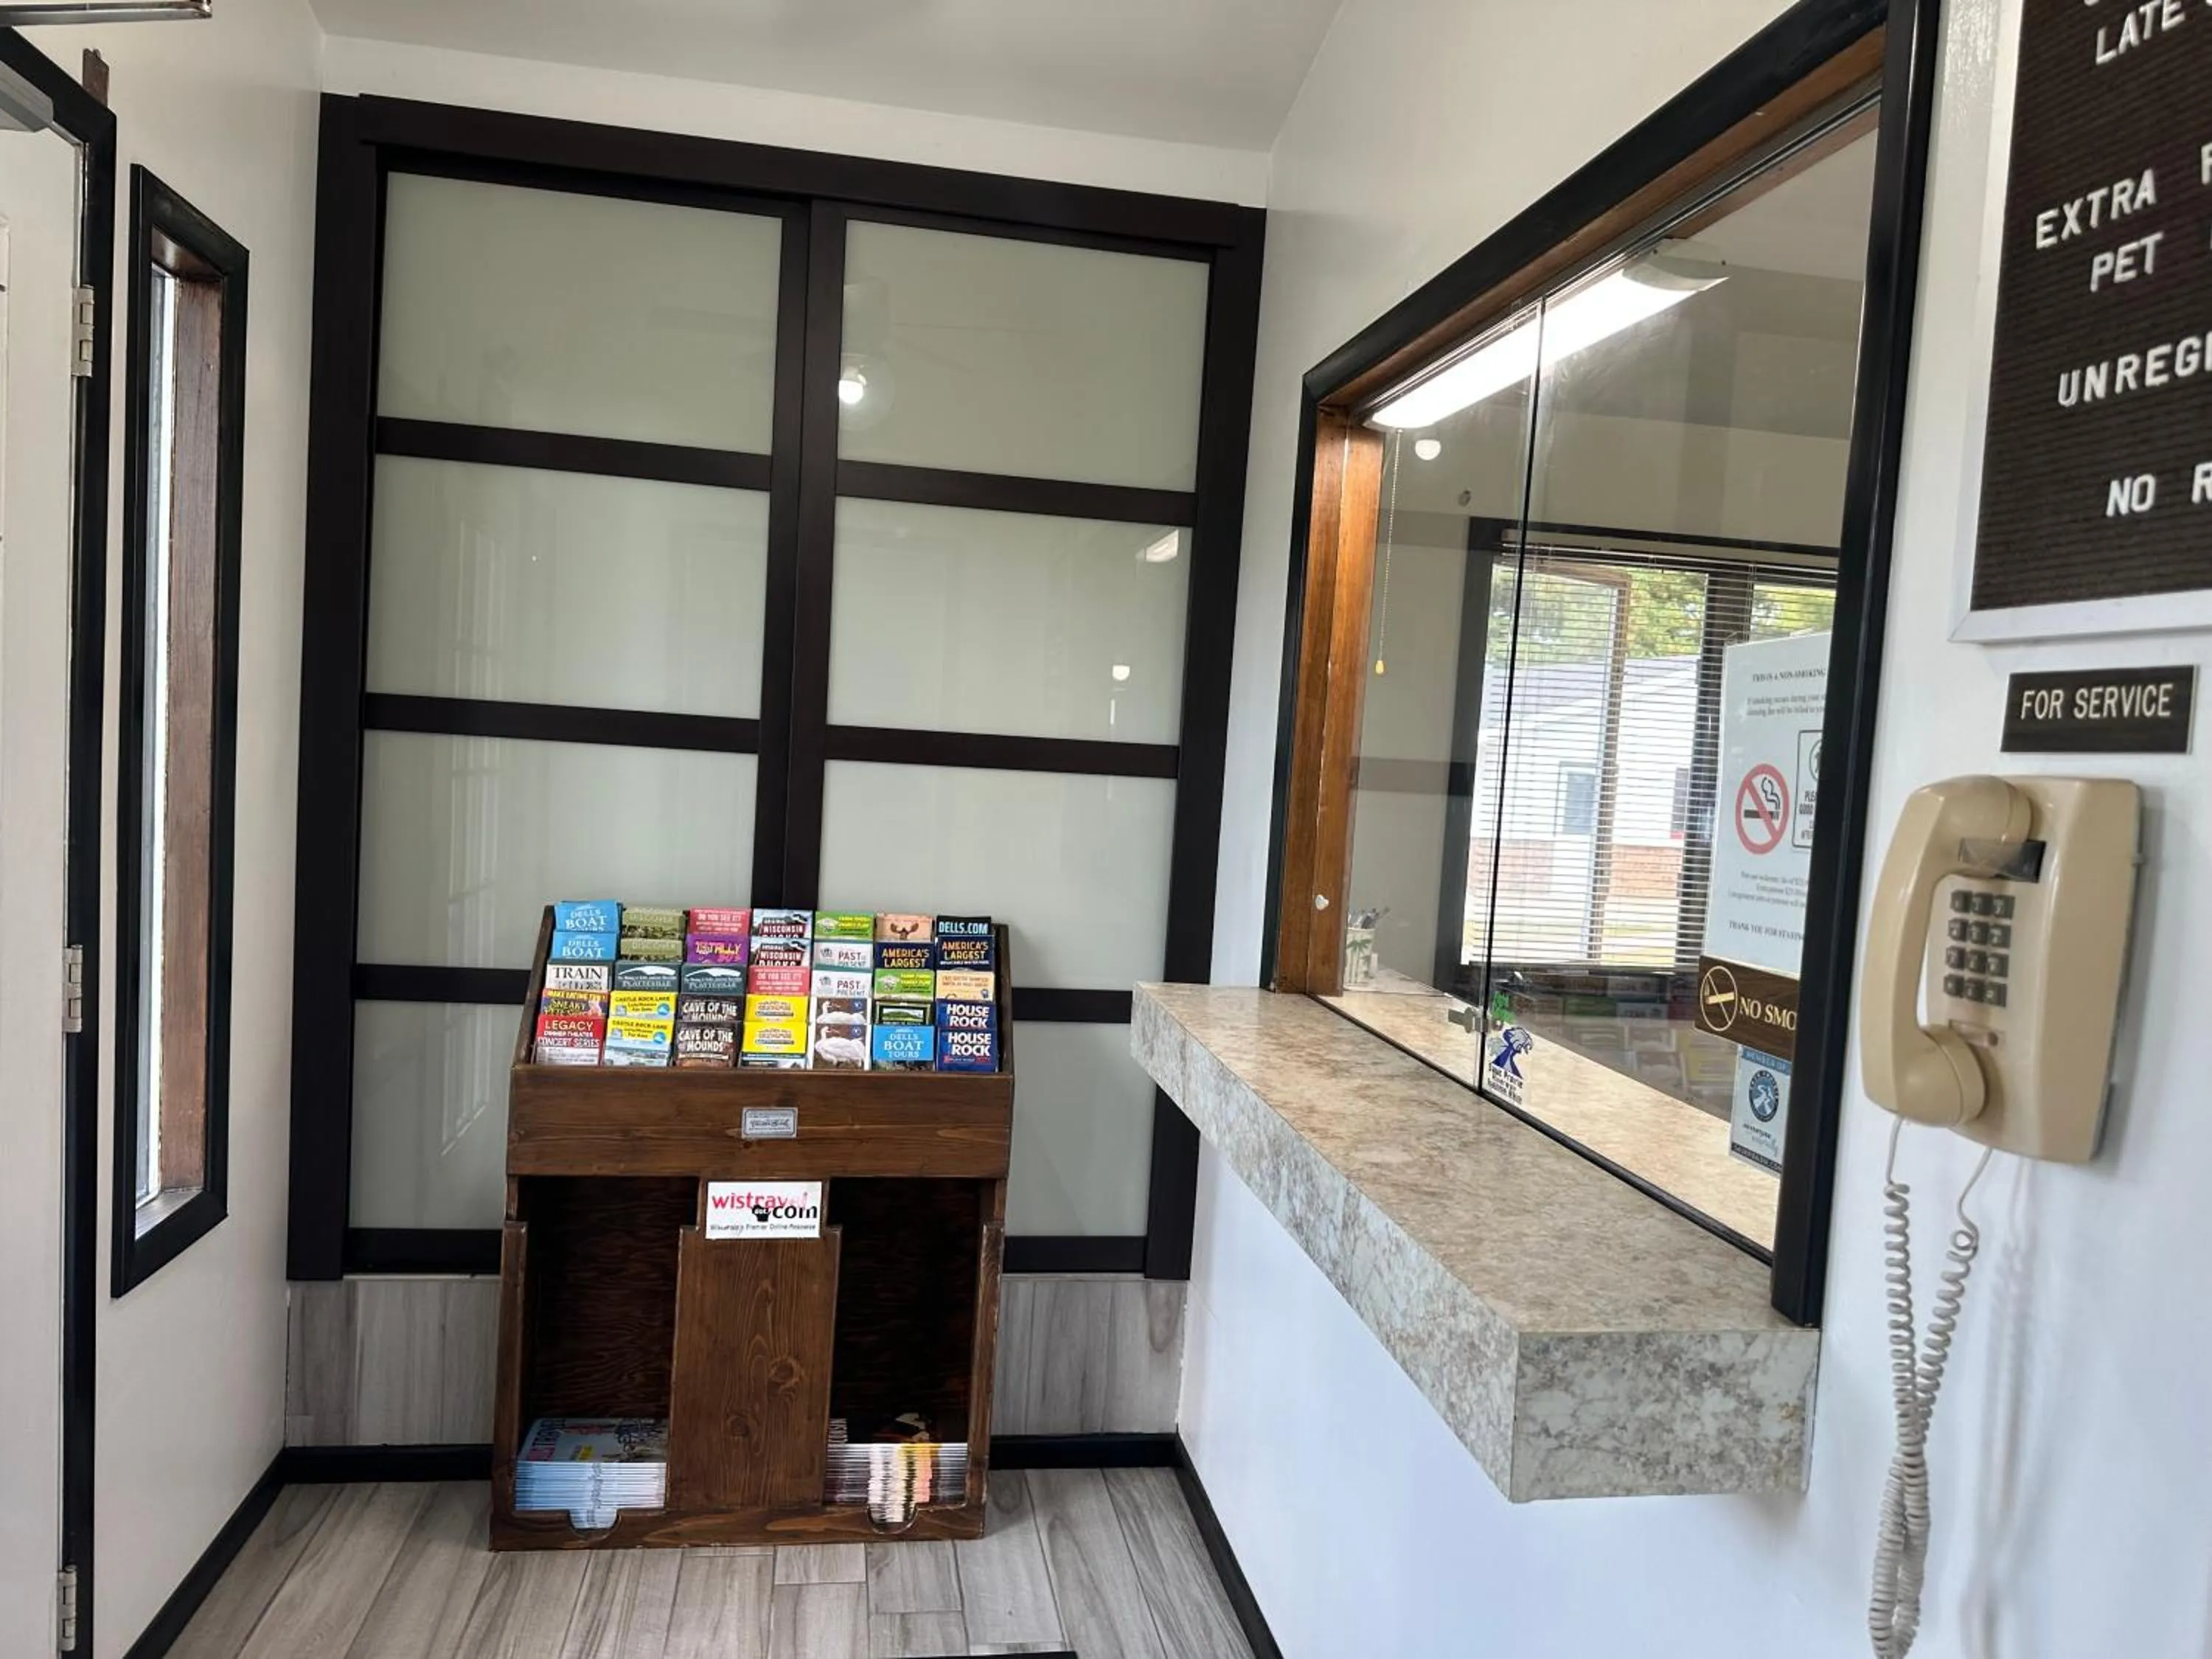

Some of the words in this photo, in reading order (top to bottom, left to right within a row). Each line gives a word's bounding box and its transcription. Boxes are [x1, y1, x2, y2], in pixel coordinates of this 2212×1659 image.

[2096, 0, 2185, 65] LATE
[2036, 168, 2157, 249] EXTRA
[2090, 231, 2164, 293] PET
[2106, 473, 2156, 517] NO
[2021, 689, 2064, 720] FOR
[2073, 684, 2174, 719] SERVICE
[565, 915, 608, 930] BOAT
[939, 922, 989, 934] DELLS.COM
[942, 942, 989, 950] AMERICA'S
[562, 947, 605, 958] BOAT
[760, 951, 801, 960] WISCONSIN
[838, 951, 861, 961] PAST
[882, 948, 930, 958] AMERICA'S
[945, 950, 985, 960] LARGEST
[885, 959, 925, 967] LARGEST
[553, 967, 602, 979] TRAIN
[837, 980, 860, 990] PAST
[682, 1002, 706, 1013] CAVE
[708, 1002, 720, 1012] OF
[721, 1003, 737, 1016] THE
[947, 1004, 990, 1018] HOUSE
[1739, 996, 1761, 1019] NO
[1764, 1004, 1797, 1031] SMO
[545, 1020, 594, 1031] LEGACY
[949, 1016, 987, 1028] ROCK
[678, 1029, 700, 1041] CAVE
[703, 1029, 716, 1040] OF
[717, 1030, 734, 1043] THE
[948, 1032, 992, 1045] HOUSE
[686, 1040, 723, 1051] MOUNDS
[884, 1040, 924, 1051] BOAT
[952, 1044, 990, 1057] ROCK
